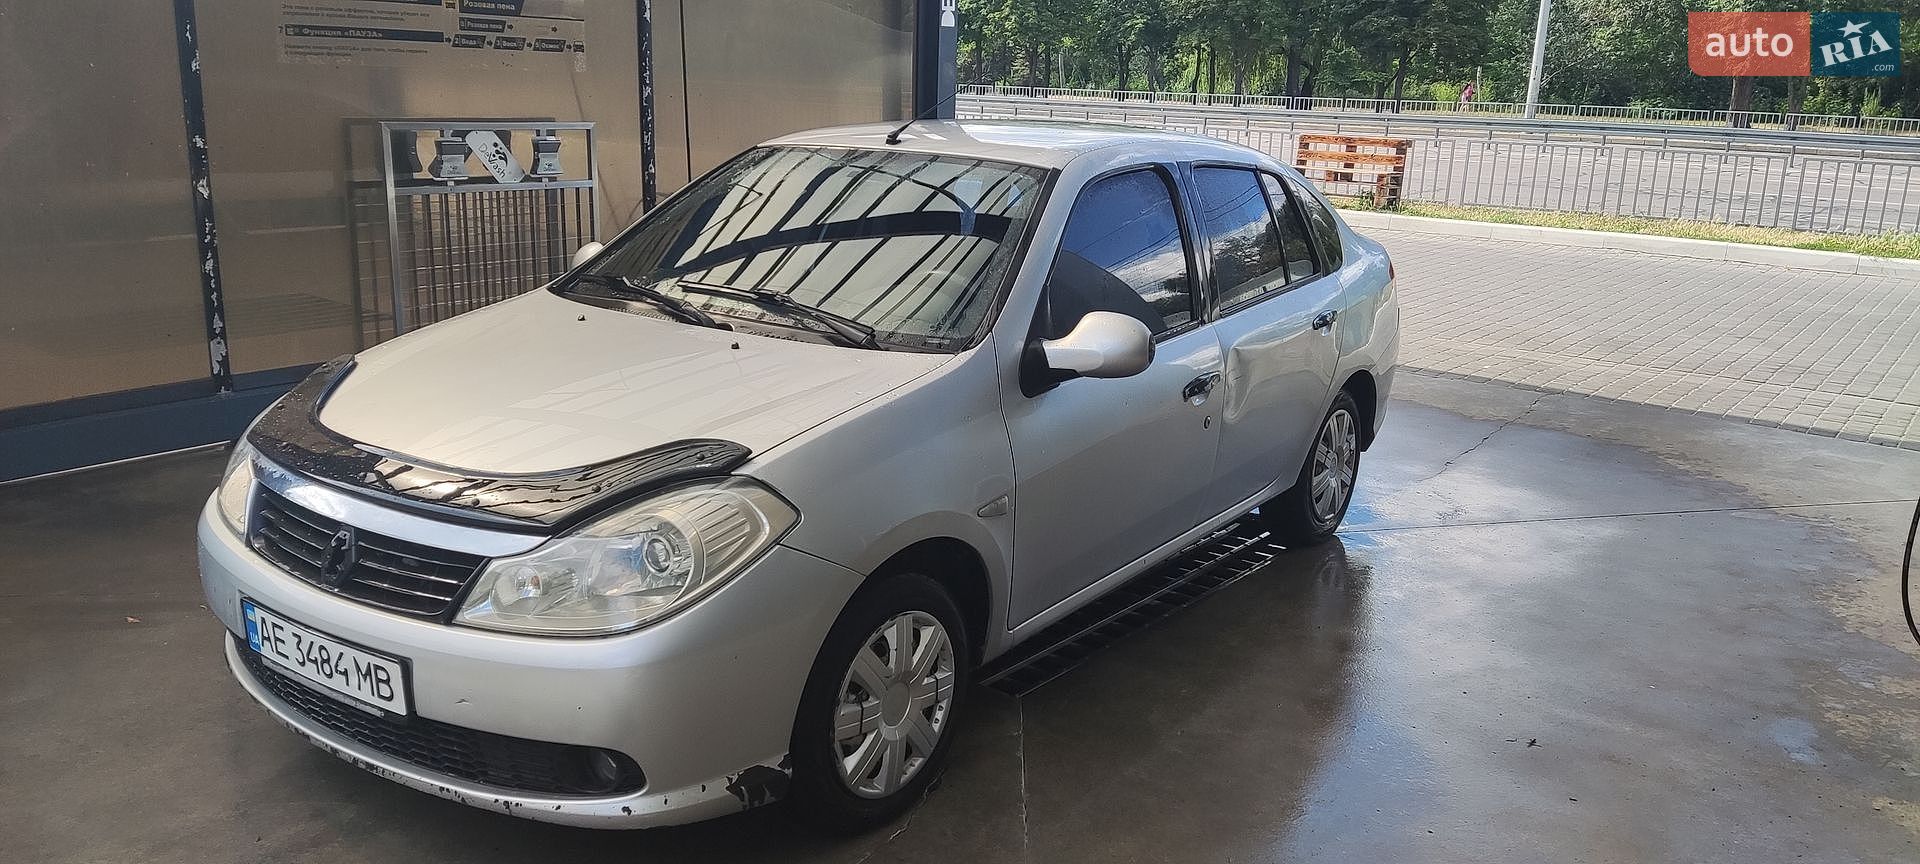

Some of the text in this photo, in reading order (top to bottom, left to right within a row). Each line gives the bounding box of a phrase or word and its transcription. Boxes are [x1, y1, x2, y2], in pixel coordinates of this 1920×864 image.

[303, 27, 340, 36] Функция
[250, 631, 261, 646] UA
[260, 617, 394, 702] AE 3484 MB
